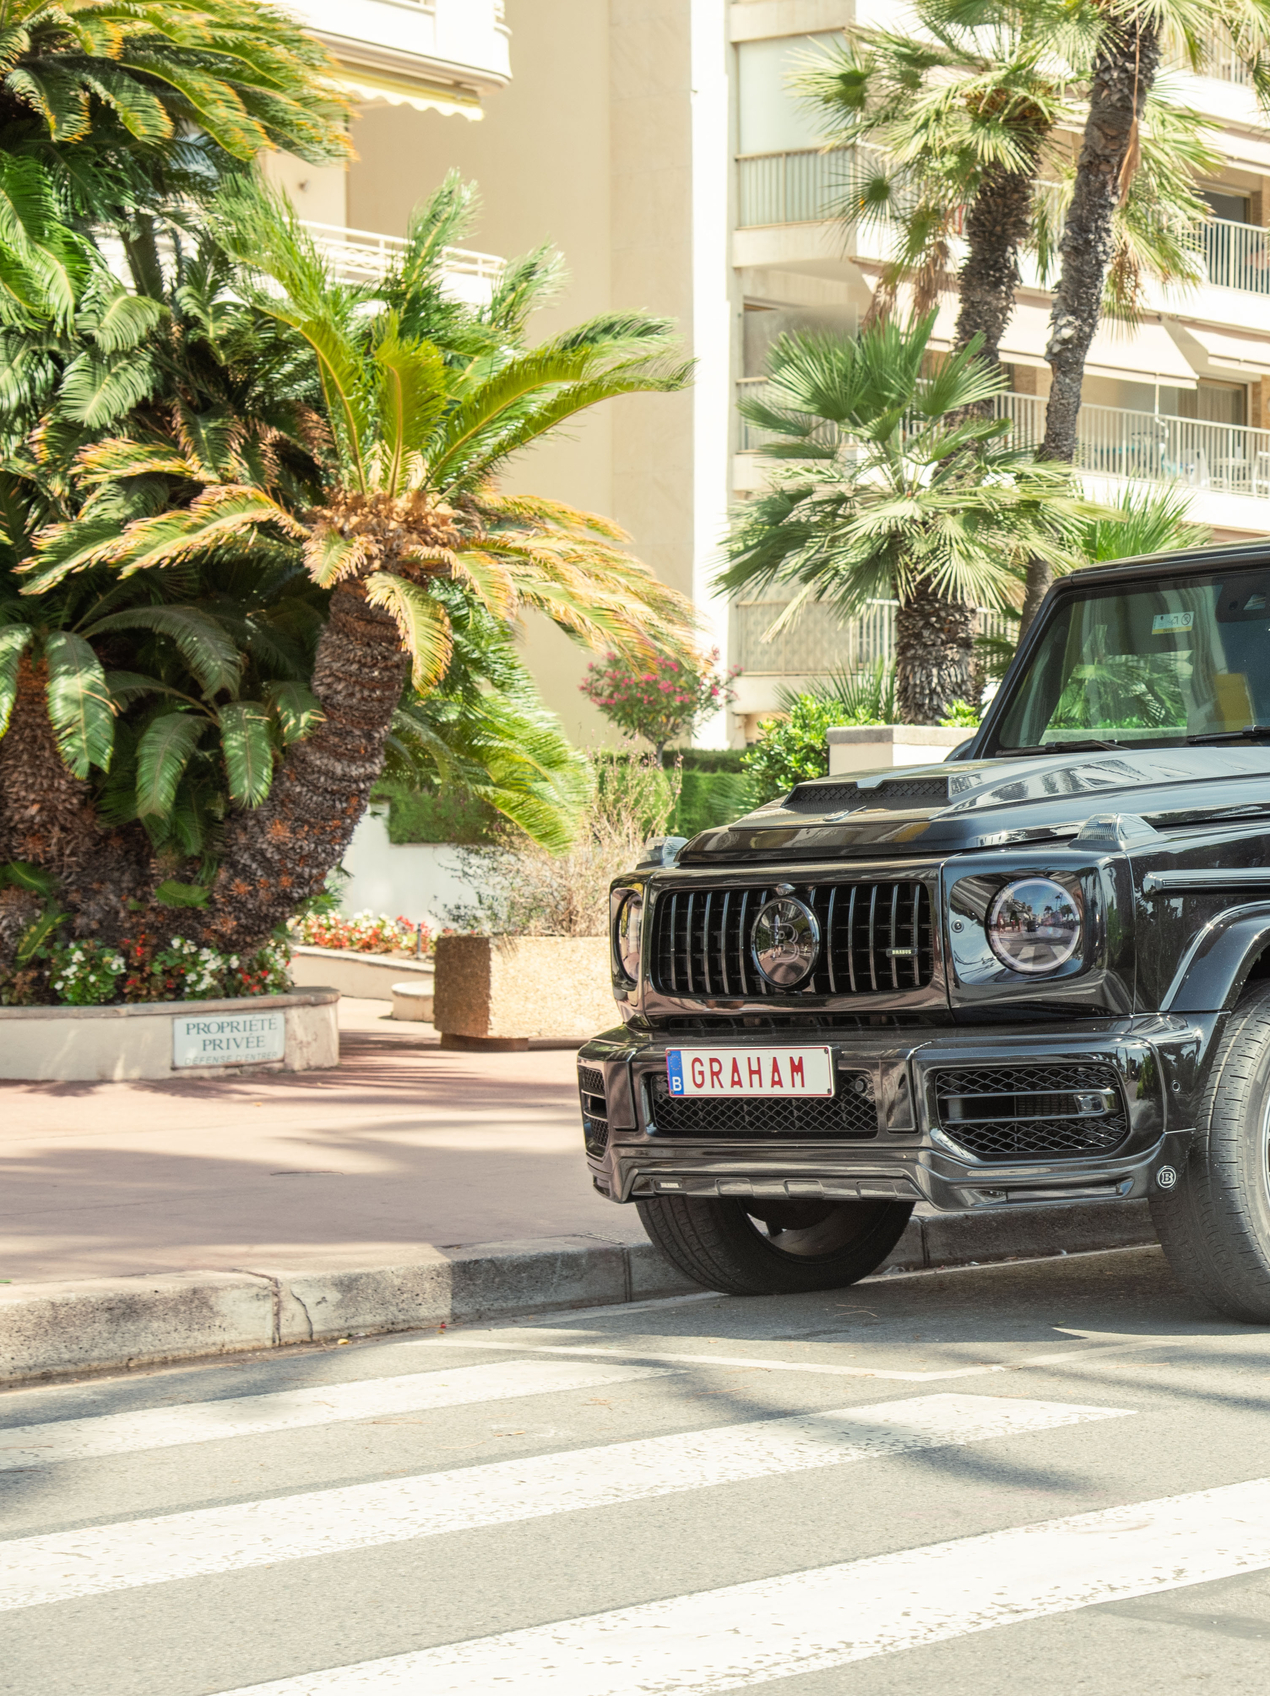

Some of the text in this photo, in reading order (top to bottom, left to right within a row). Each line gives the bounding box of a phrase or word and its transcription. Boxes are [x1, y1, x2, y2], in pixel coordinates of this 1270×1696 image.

[185, 1014, 278, 1035] PROPRIÉTÉ
[202, 1033, 266, 1051] PRIVÉE
[691, 1056, 805, 1089] GRAHAM
[672, 1076, 682, 1091] B
[1161, 1171, 1174, 1184] B
